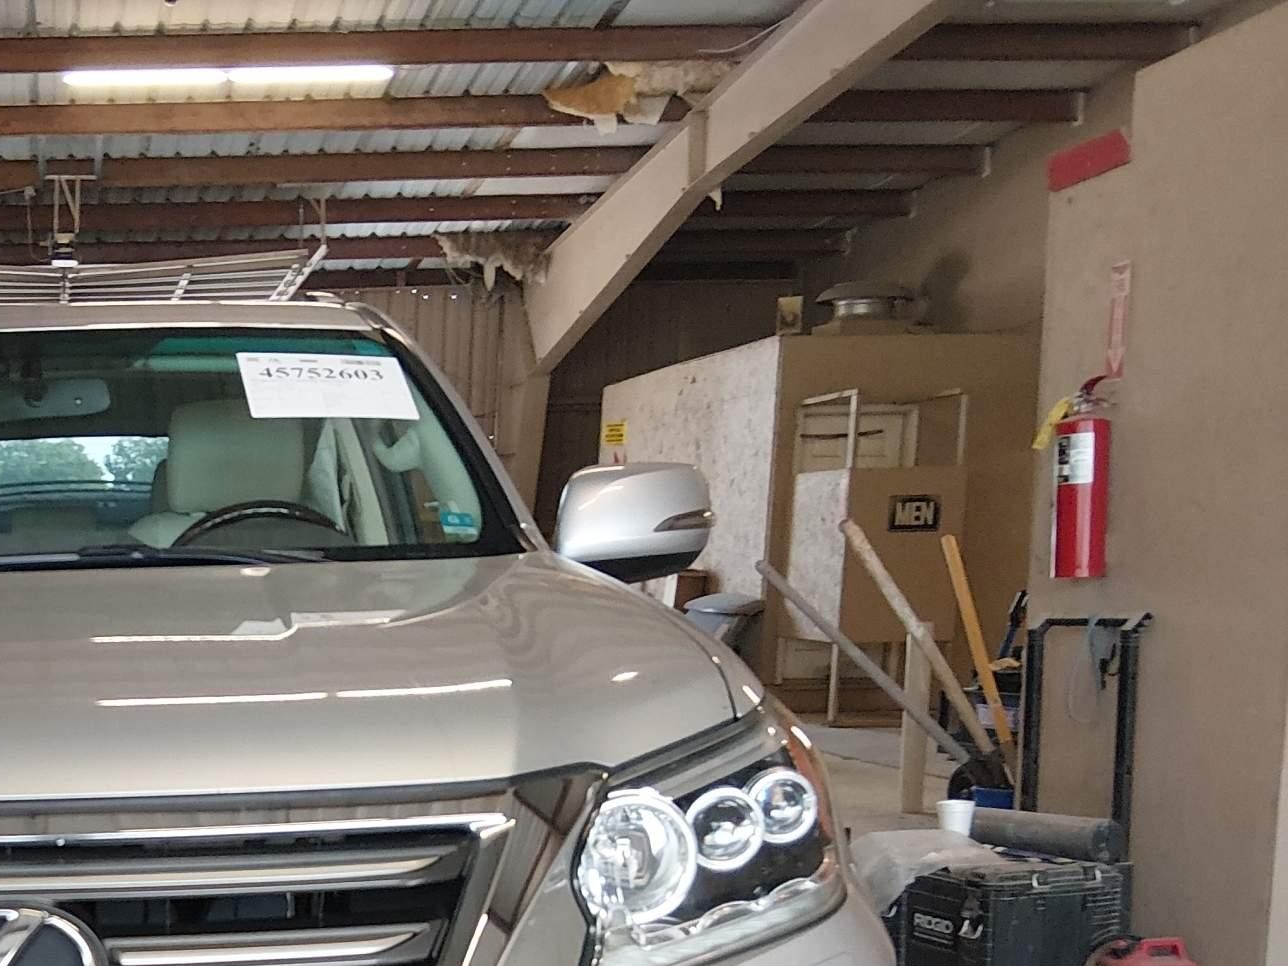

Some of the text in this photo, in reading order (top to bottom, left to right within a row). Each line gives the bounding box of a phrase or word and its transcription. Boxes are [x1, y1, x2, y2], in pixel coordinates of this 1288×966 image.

[259, 367, 384, 381] 45752603
[894, 501, 935, 526] MEN
[914, 912, 954, 933] RIDGID
